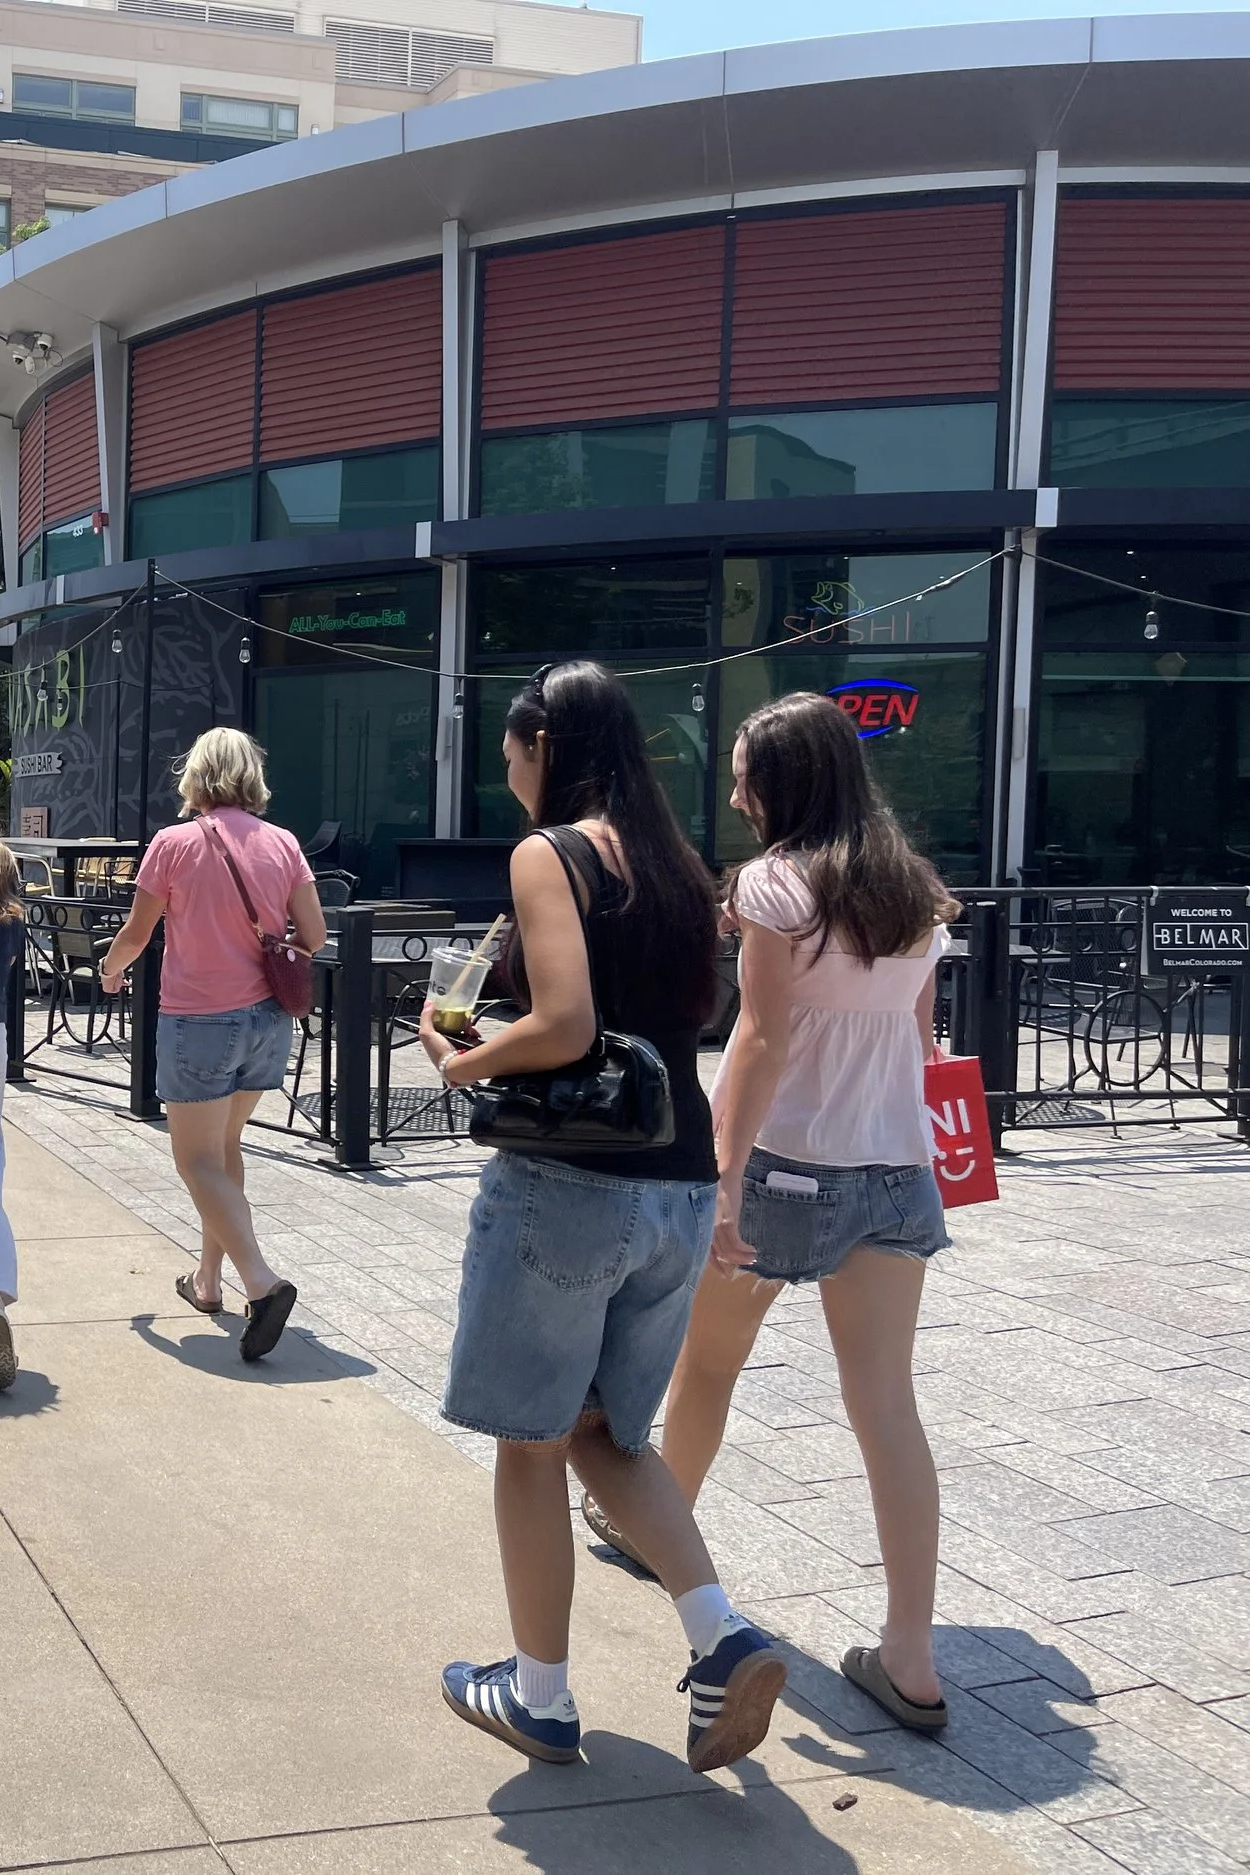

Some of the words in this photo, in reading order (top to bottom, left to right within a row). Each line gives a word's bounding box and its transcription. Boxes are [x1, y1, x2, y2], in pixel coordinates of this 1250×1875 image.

[783, 611, 910, 644] SUSHI
[828, 694, 919, 726] PEN
[20, 756, 37, 774] SUSHI
[37, 754, 53, 773] BAR
[1170, 908, 1218, 917] WELCOME
[1219, 908, 1233, 917] TO
[1155, 923, 1247, 949] BELMAR
